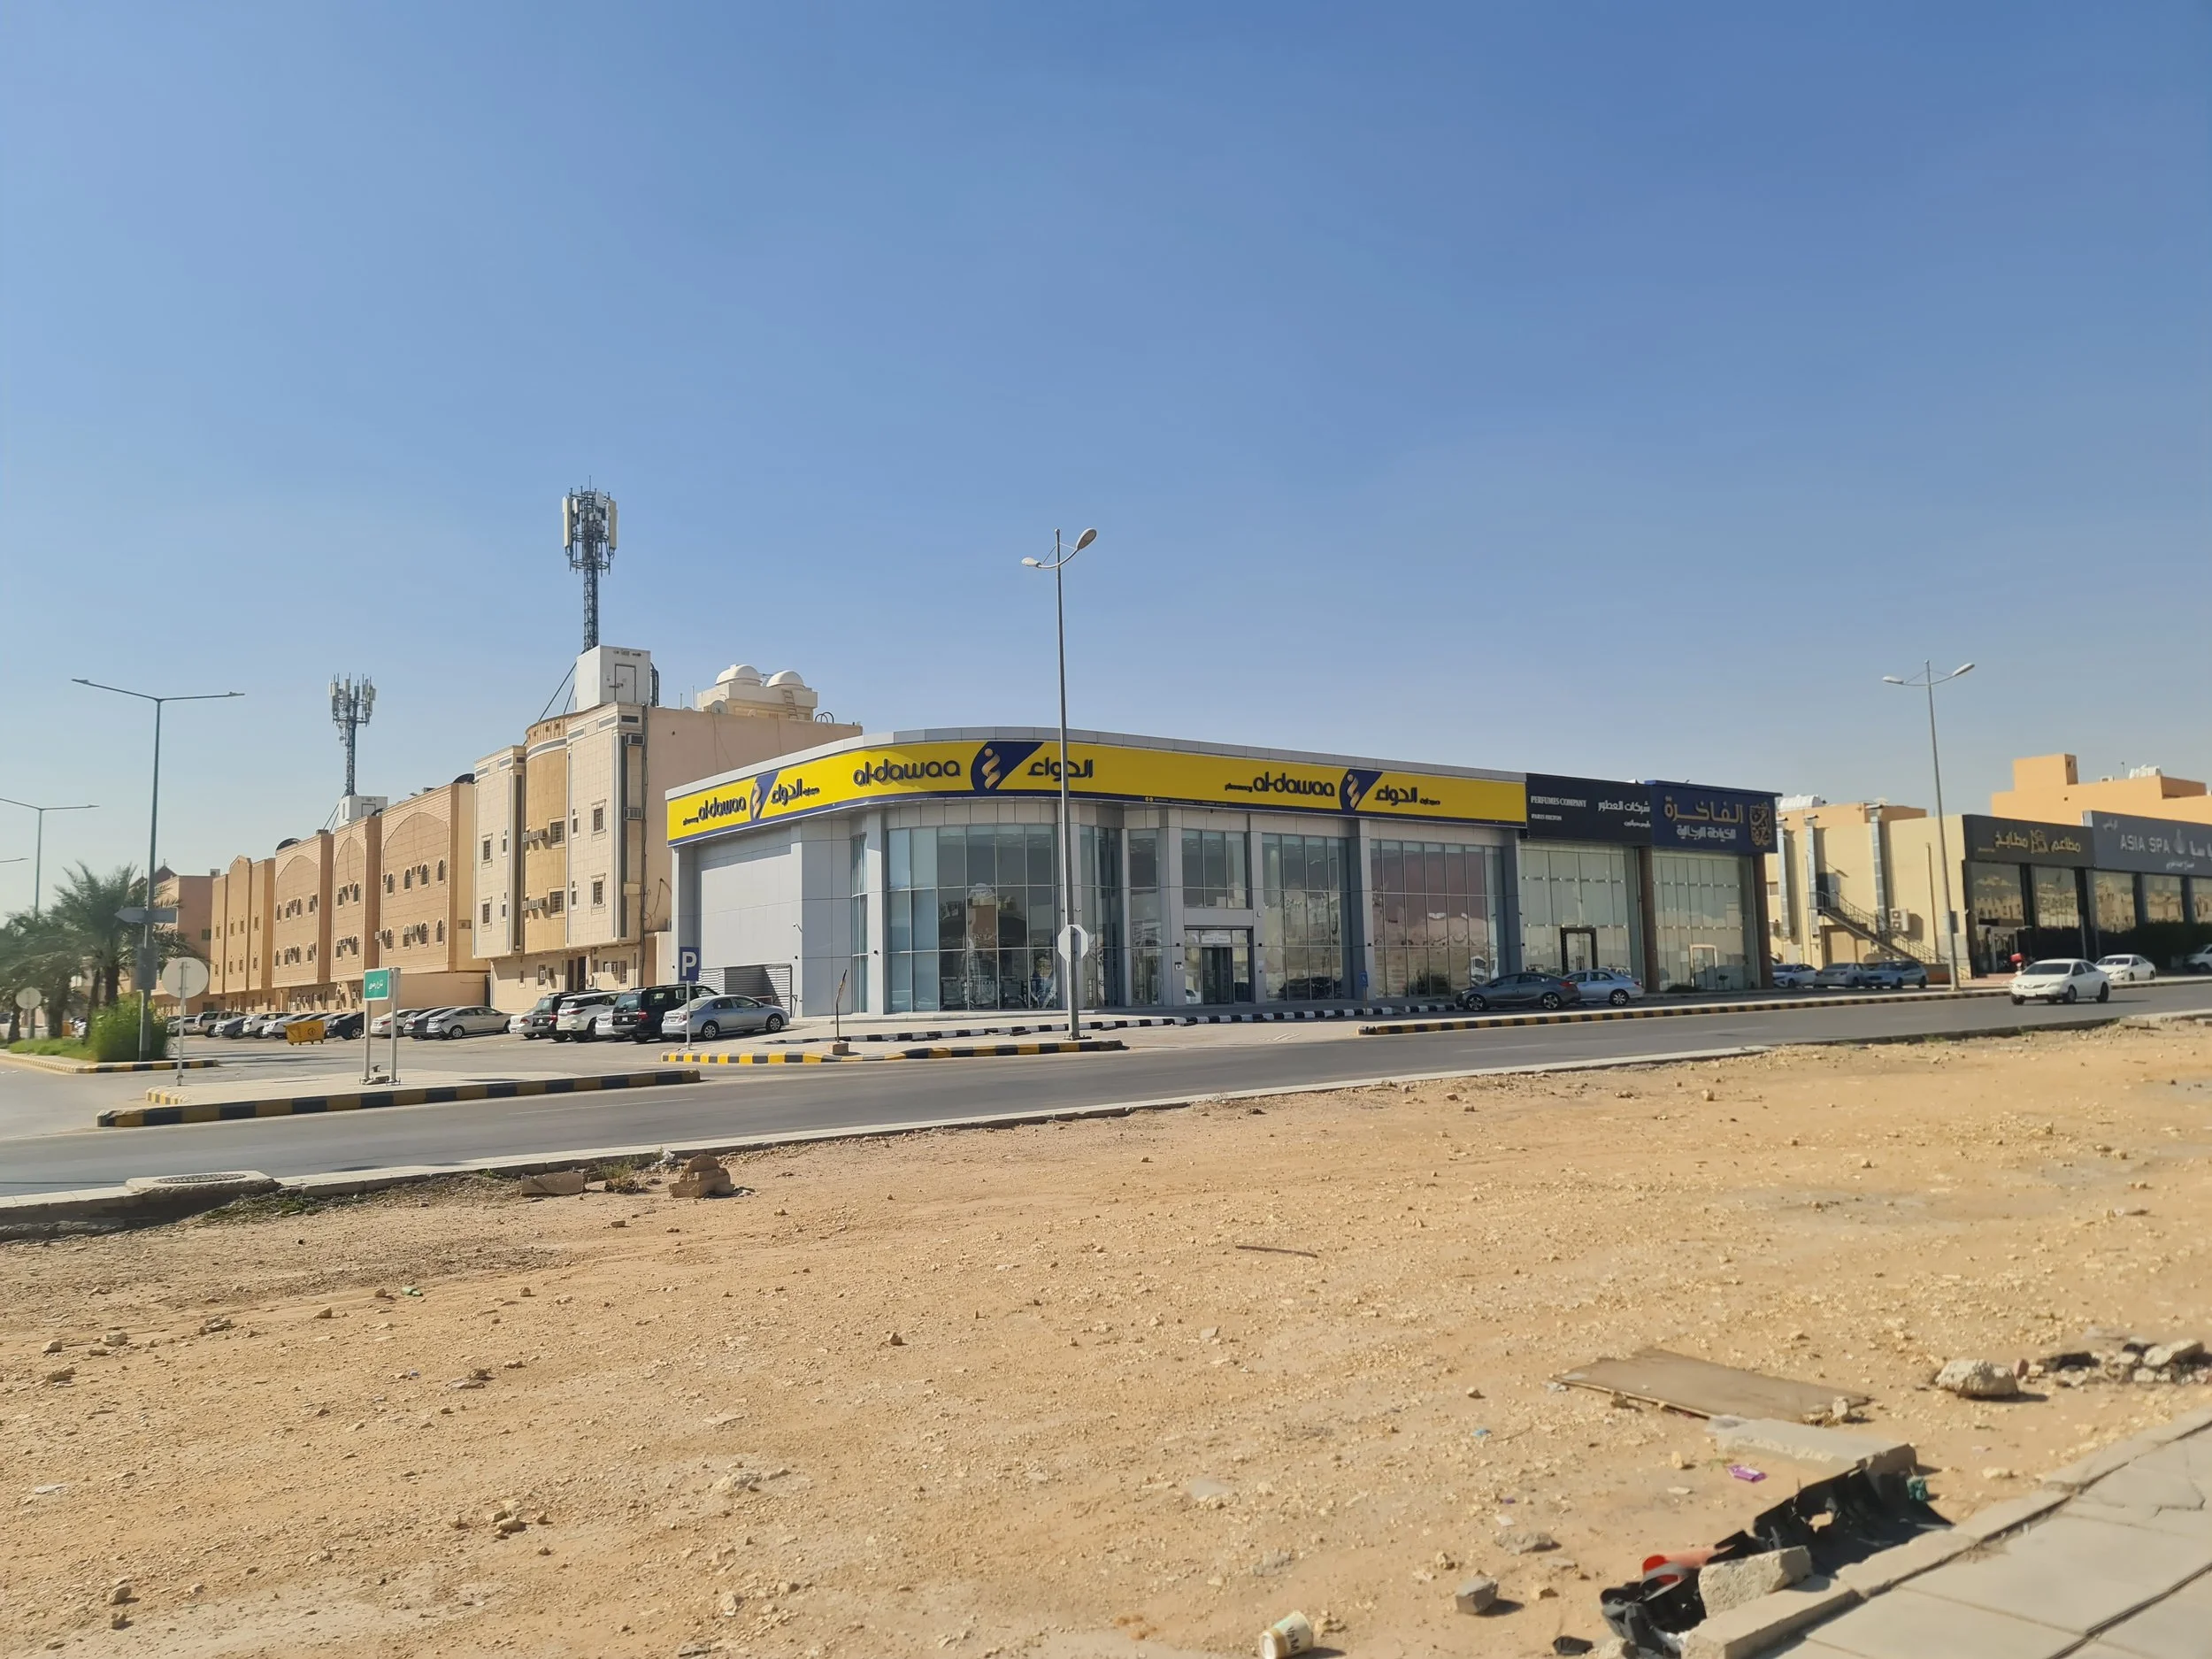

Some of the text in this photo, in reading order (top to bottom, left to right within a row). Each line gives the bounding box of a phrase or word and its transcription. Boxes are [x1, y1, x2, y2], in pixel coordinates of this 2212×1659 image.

[853, 758, 961, 787] al-dawaa
[1027, 757, 1094, 782] الدواء
[771, 778, 803, 806] الدواء
[1253, 771, 1335, 796] al-dawaa
[1374, 785, 1418, 806] الدواء
[698, 796, 747, 821] al-dawaa
[1530, 795, 1587, 808] PERFUMES COMPANY
[1597, 799, 1650, 815] شركات العطور
[1664, 795, 1743, 824] الفاخرة
[2120, 834, 2170, 854] ASIA SPA
[682, 951, 697, 976] P
